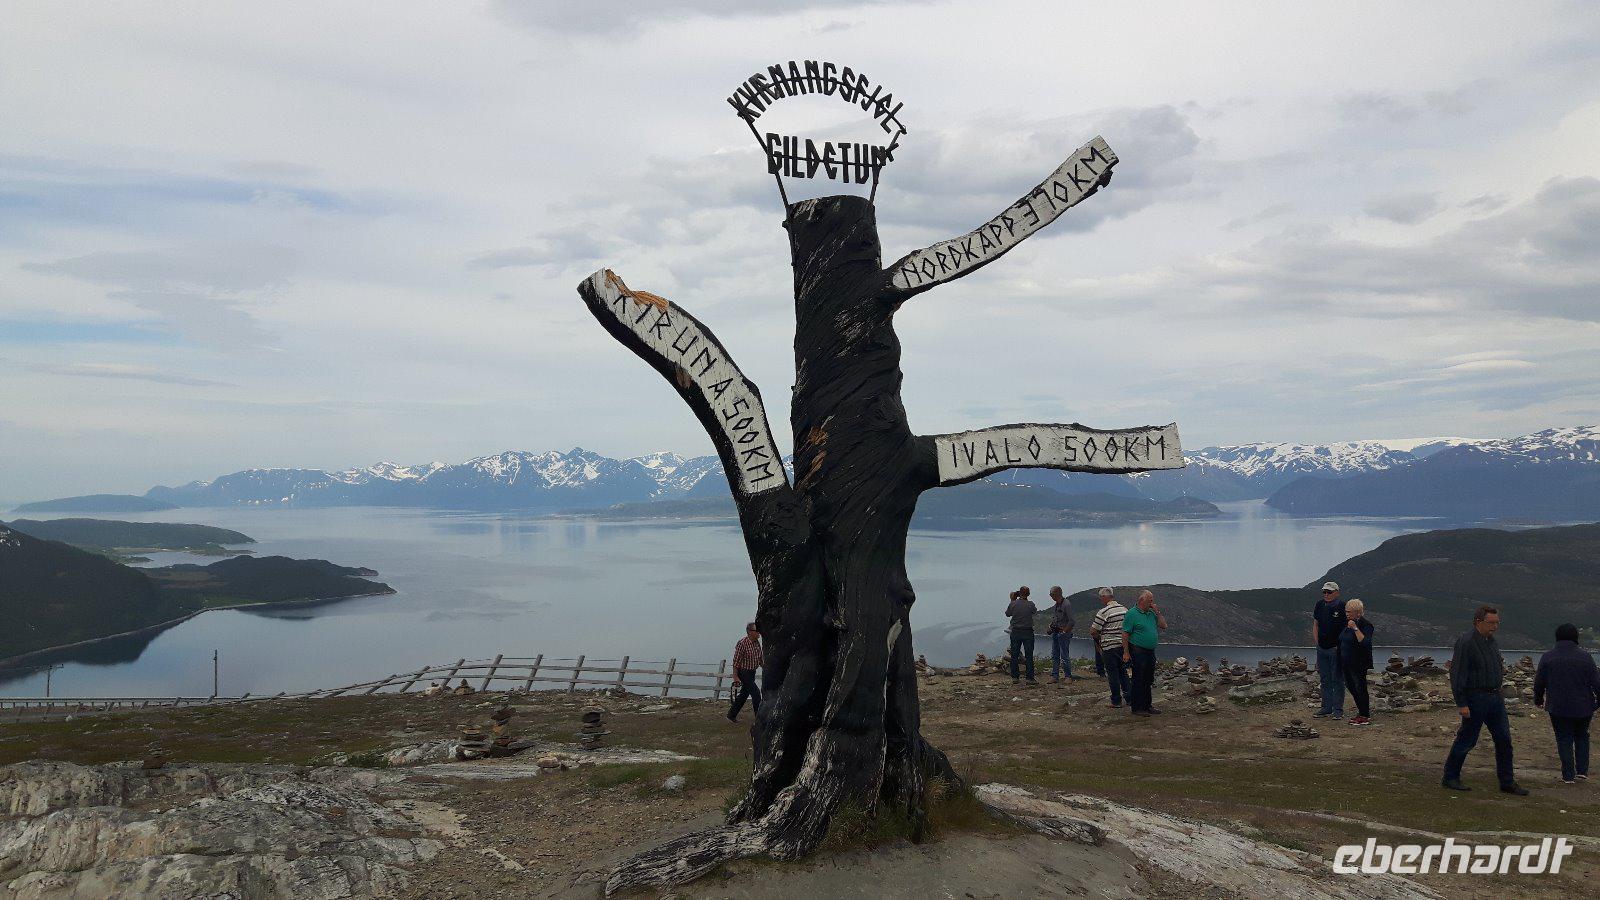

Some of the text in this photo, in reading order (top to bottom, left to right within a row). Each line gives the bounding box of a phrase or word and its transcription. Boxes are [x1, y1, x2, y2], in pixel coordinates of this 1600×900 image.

[901, 214, 1016, 288] NORDKAPP
[612, 294, 735, 401] KIRUNA
[951, 434, 1041, 468] IVALO
